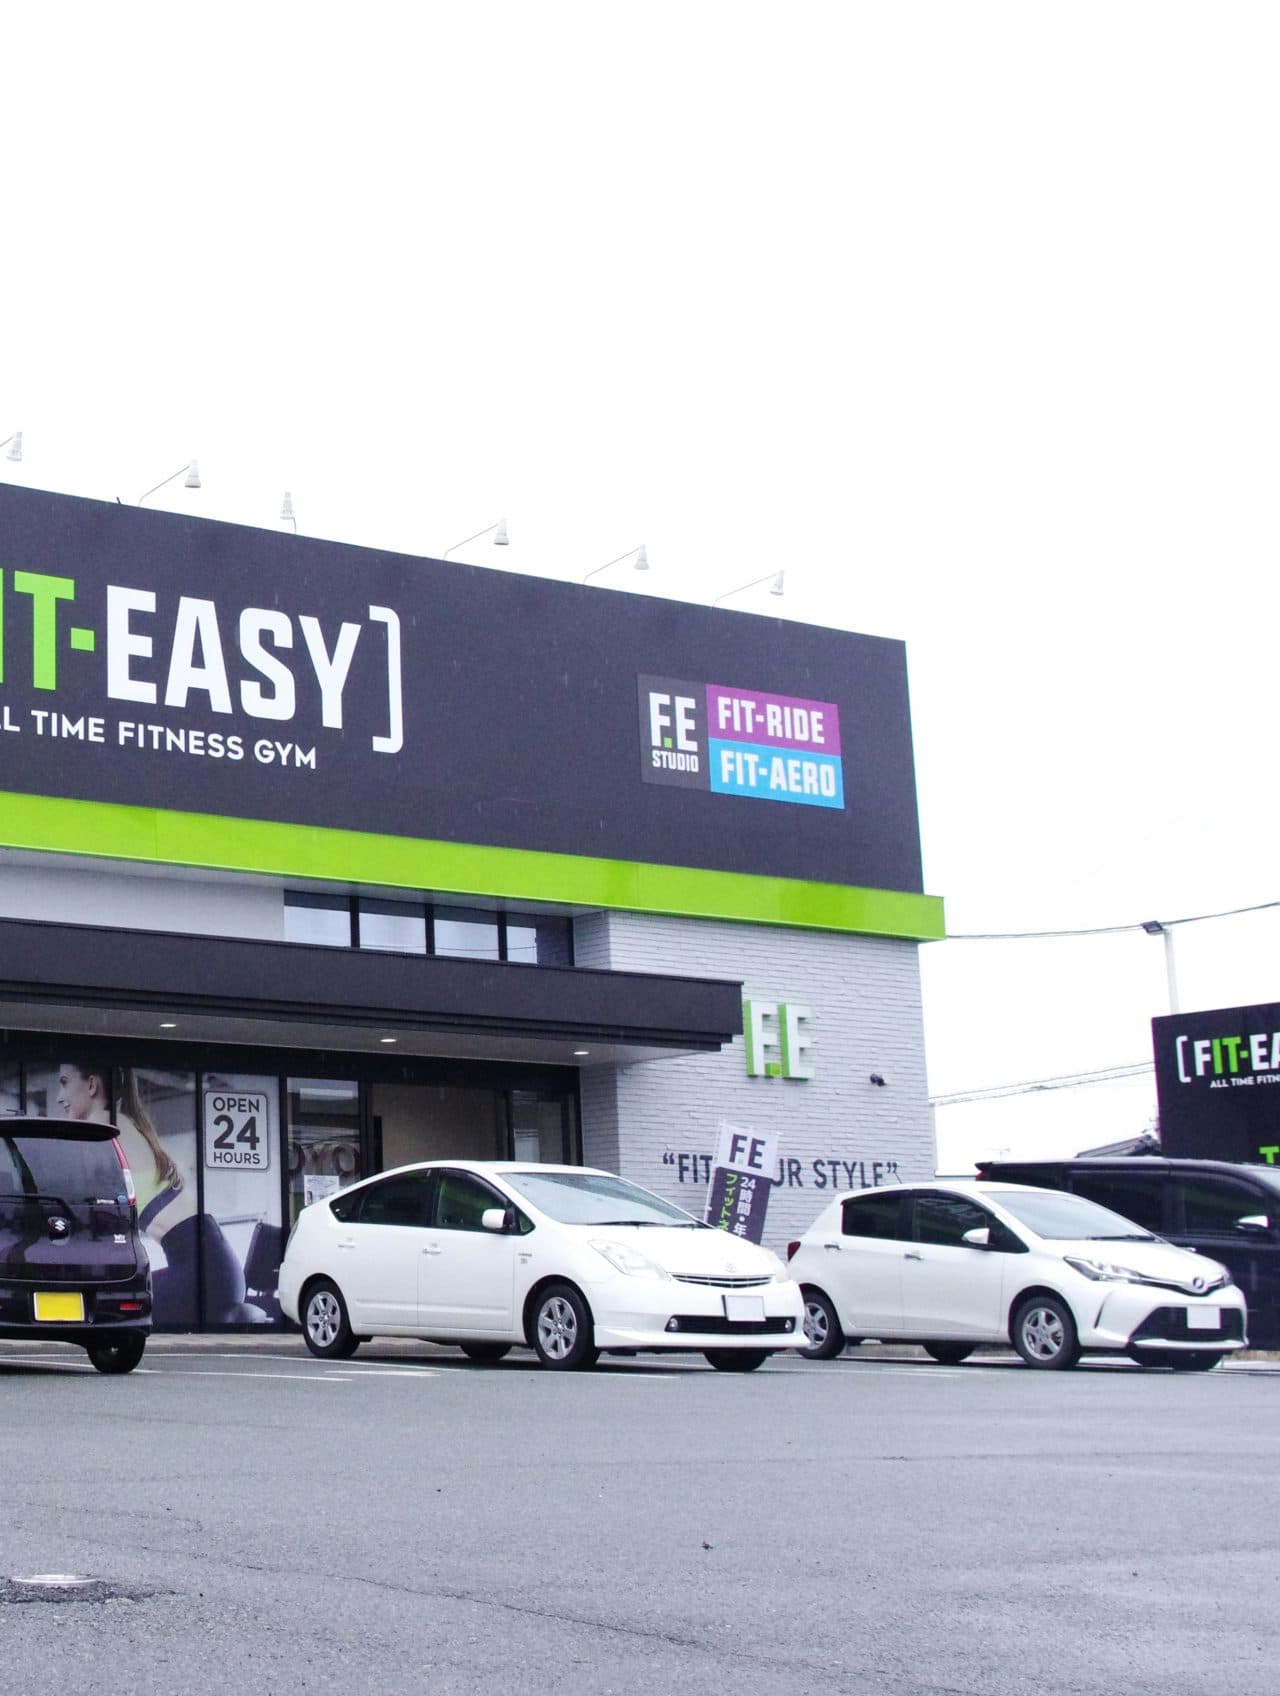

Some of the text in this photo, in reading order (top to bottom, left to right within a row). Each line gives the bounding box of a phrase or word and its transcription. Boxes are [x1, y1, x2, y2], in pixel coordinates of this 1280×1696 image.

[717, 695, 825, 744] FIT-RIDE
[31, 709, 105, 743] TIME
[118, 721, 244, 761] FITNESS
[254, 739, 317, 769] GYM
[652, 750, 699, 772] STUDIO
[720, 750, 836, 797] FIT-AERO
[1210, 1079, 1229, 1088] ALL
[1230, 1076, 1255, 1086] TIME
[213, 1097, 260, 1112] OPEN
[213, 1115, 260, 1150] 24
[213, 1152, 260, 1164] HOURS
